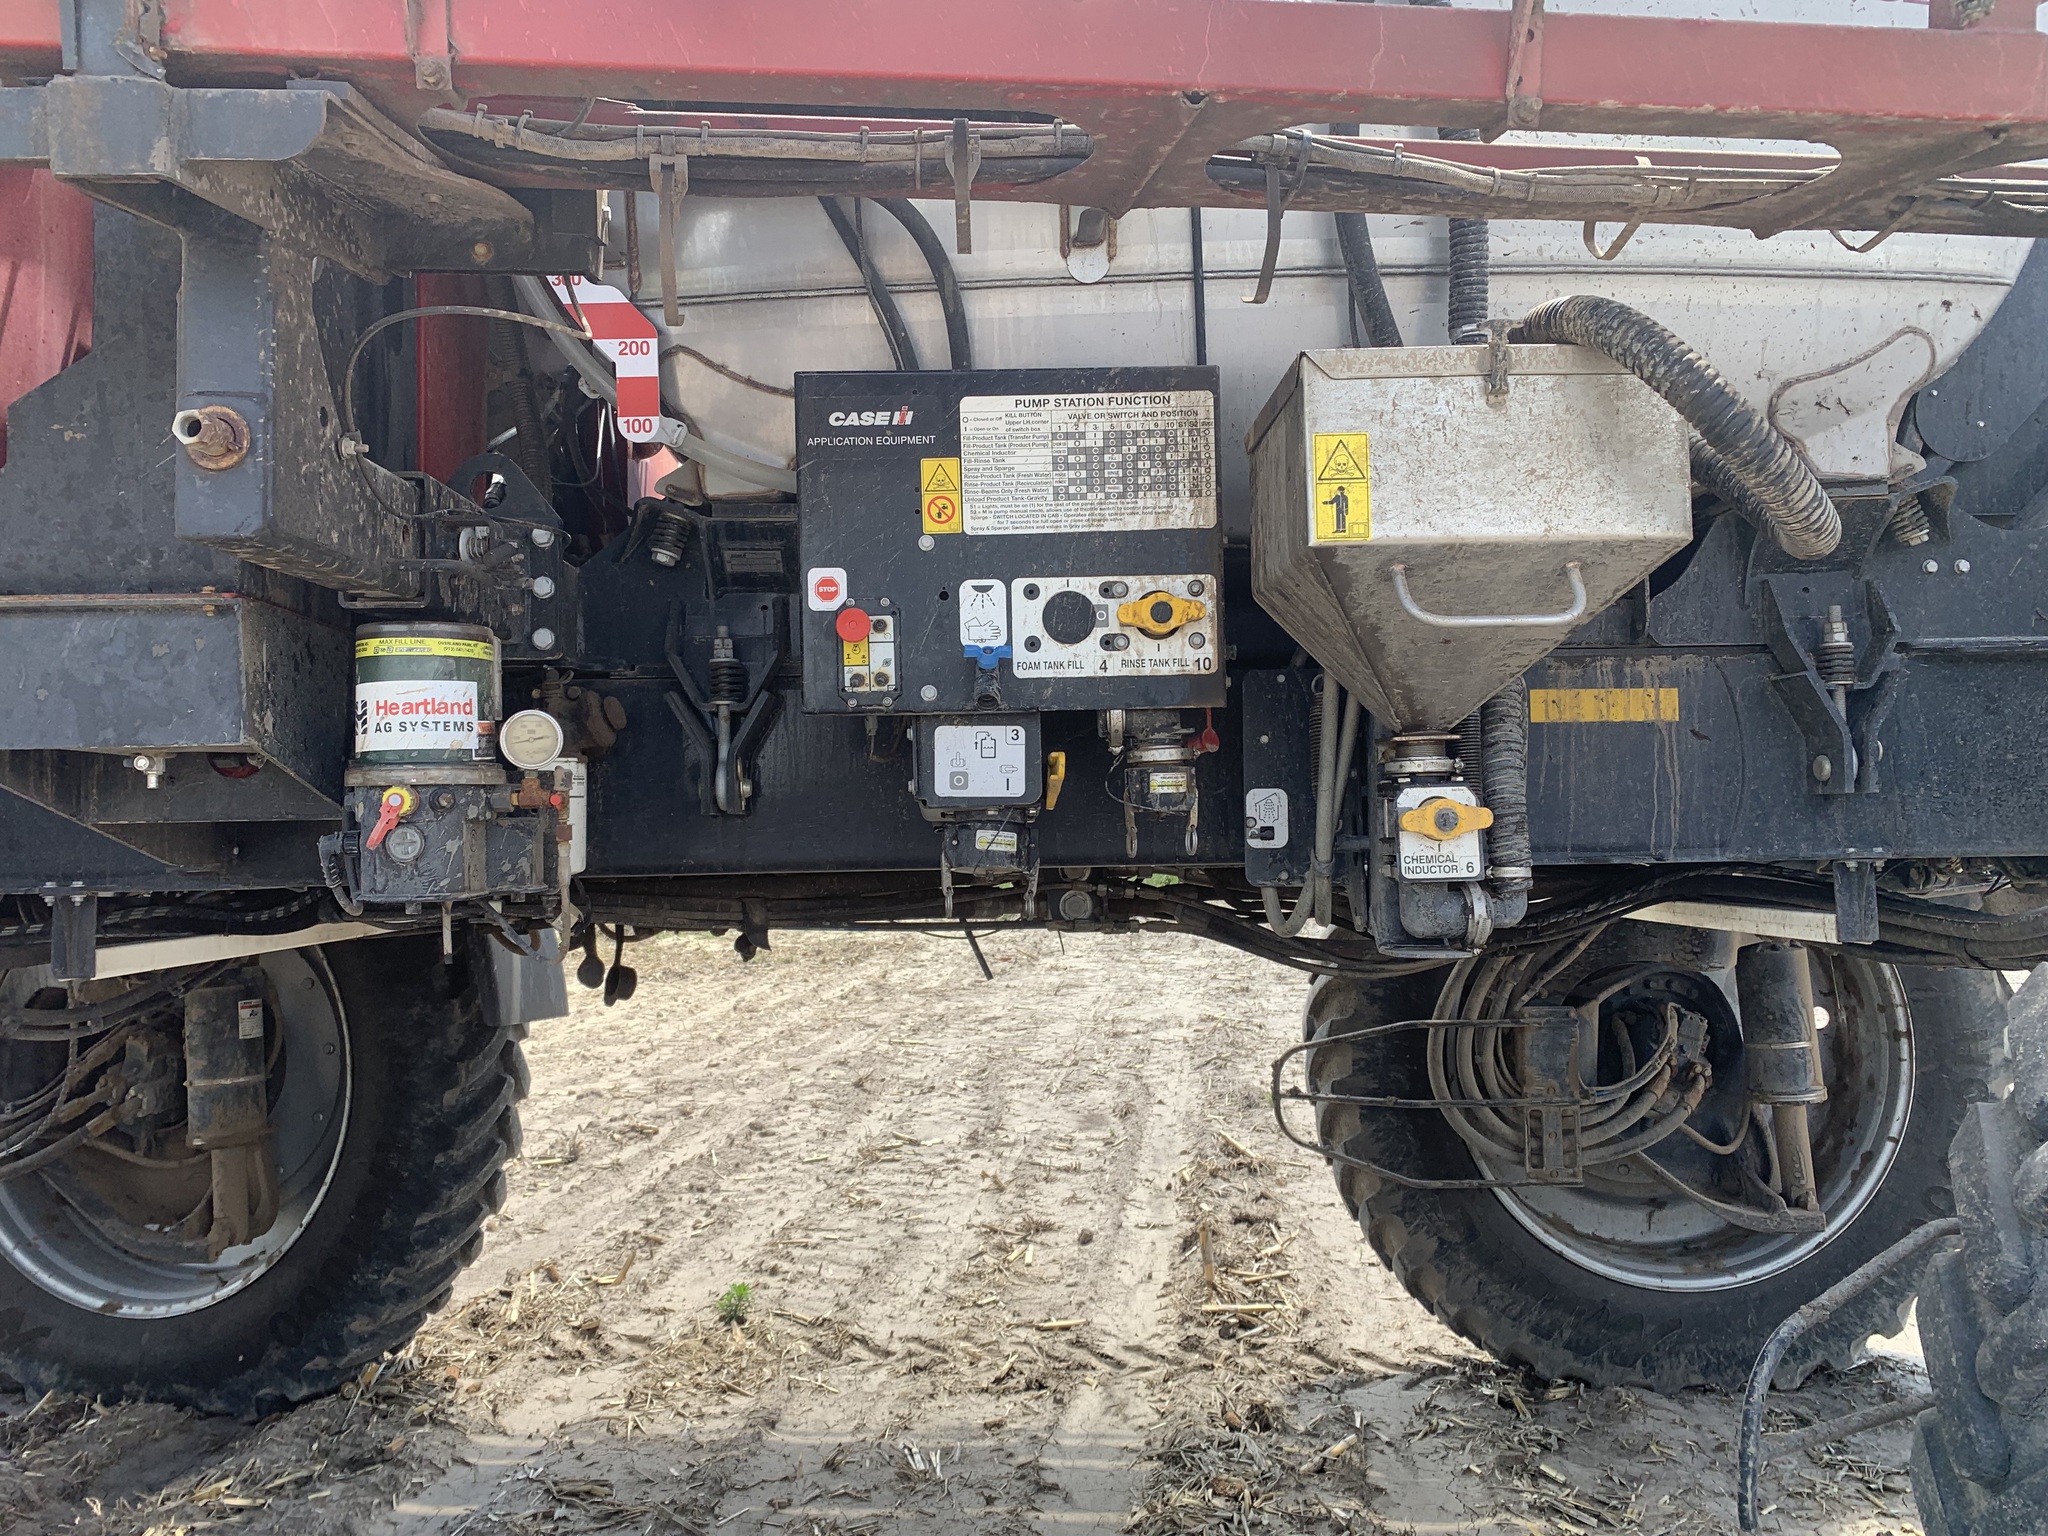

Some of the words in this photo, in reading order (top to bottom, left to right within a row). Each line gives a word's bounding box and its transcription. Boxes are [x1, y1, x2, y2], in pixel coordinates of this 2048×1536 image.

[552, 275, 581, 286] 30
[618, 341, 650, 356] 200
[1015, 399, 1049, 408] PUMP
[1054, 398, 1104, 407] STATION
[1108, 396, 1170, 405] FUNCTION
[829, 411, 891, 426] CASE
[623, 419, 652, 433] 100
[807, 437, 873, 446] APPLICATION
[876, 435, 936, 445] EQUIPMENT
[1016, 661, 1041, 671] FOAM
[1043, 661, 1065, 670] TANK
[1068, 660, 1084, 669] FILL
[1099, 660, 1108, 672] 4
[1121, 659, 1146, 668] RINSE
[1149, 658, 1171, 668] TANK
[1173, 657, 1190, 667] FILL
[1194, 657, 1212, 671] 10
[375, 698, 472, 716] Heartland
[375, 722, 392, 733] AG
[399, 721, 474, 733] SYSTEMS
[1011, 729, 1019, 740] 3
[1404, 855, 1458, 864] CHEMICAL
[1404, 865, 1458, 874] INDUCTOR
[1466, 862, 1474, 873] 6
